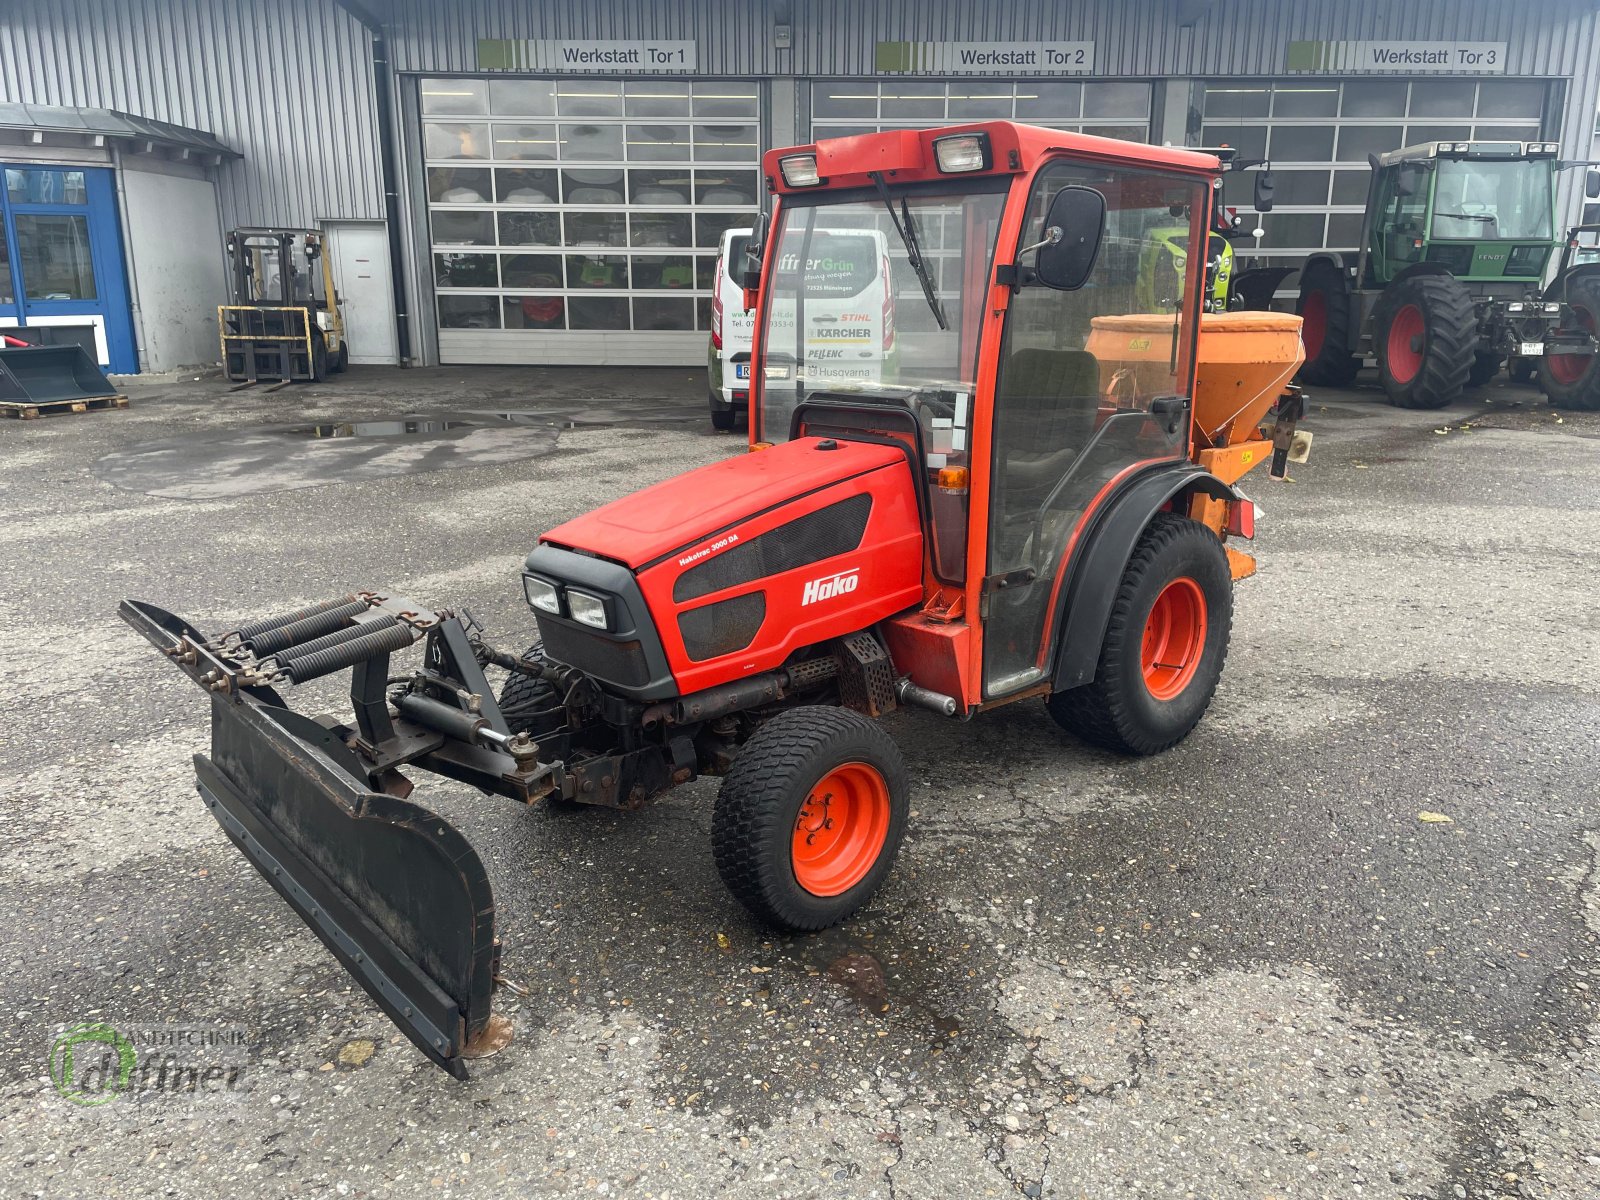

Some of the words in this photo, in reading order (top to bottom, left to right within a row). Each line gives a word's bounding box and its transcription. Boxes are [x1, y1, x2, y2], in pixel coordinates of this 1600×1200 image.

[563, 47, 640, 64] Werkstatt
[647, 48, 674, 64] Tor
[677, 48, 686, 64] 1
[960, 49, 1036, 65] Werkstatt
[1045, 49, 1072, 65] Tor
[1075, 49, 1085, 65] 2
[1373, 48, 1449, 64] Werkstatt
[1457, 49, 1483, 65] Tor
[1486, 50, 1497, 65] 3
[840, 313, 872, 321] STIHL
[817, 328, 871, 338] KÄRCHER
[808, 349, 844, 359] PELLENC
[819, 367, 870, 377] Husqvarna
[679, 547, 711, 566] Hakotrac
[711, 540, 728, 552] 3000
[728, 534, 739, 544] DA
[801, 567, 860, 606] Hako
